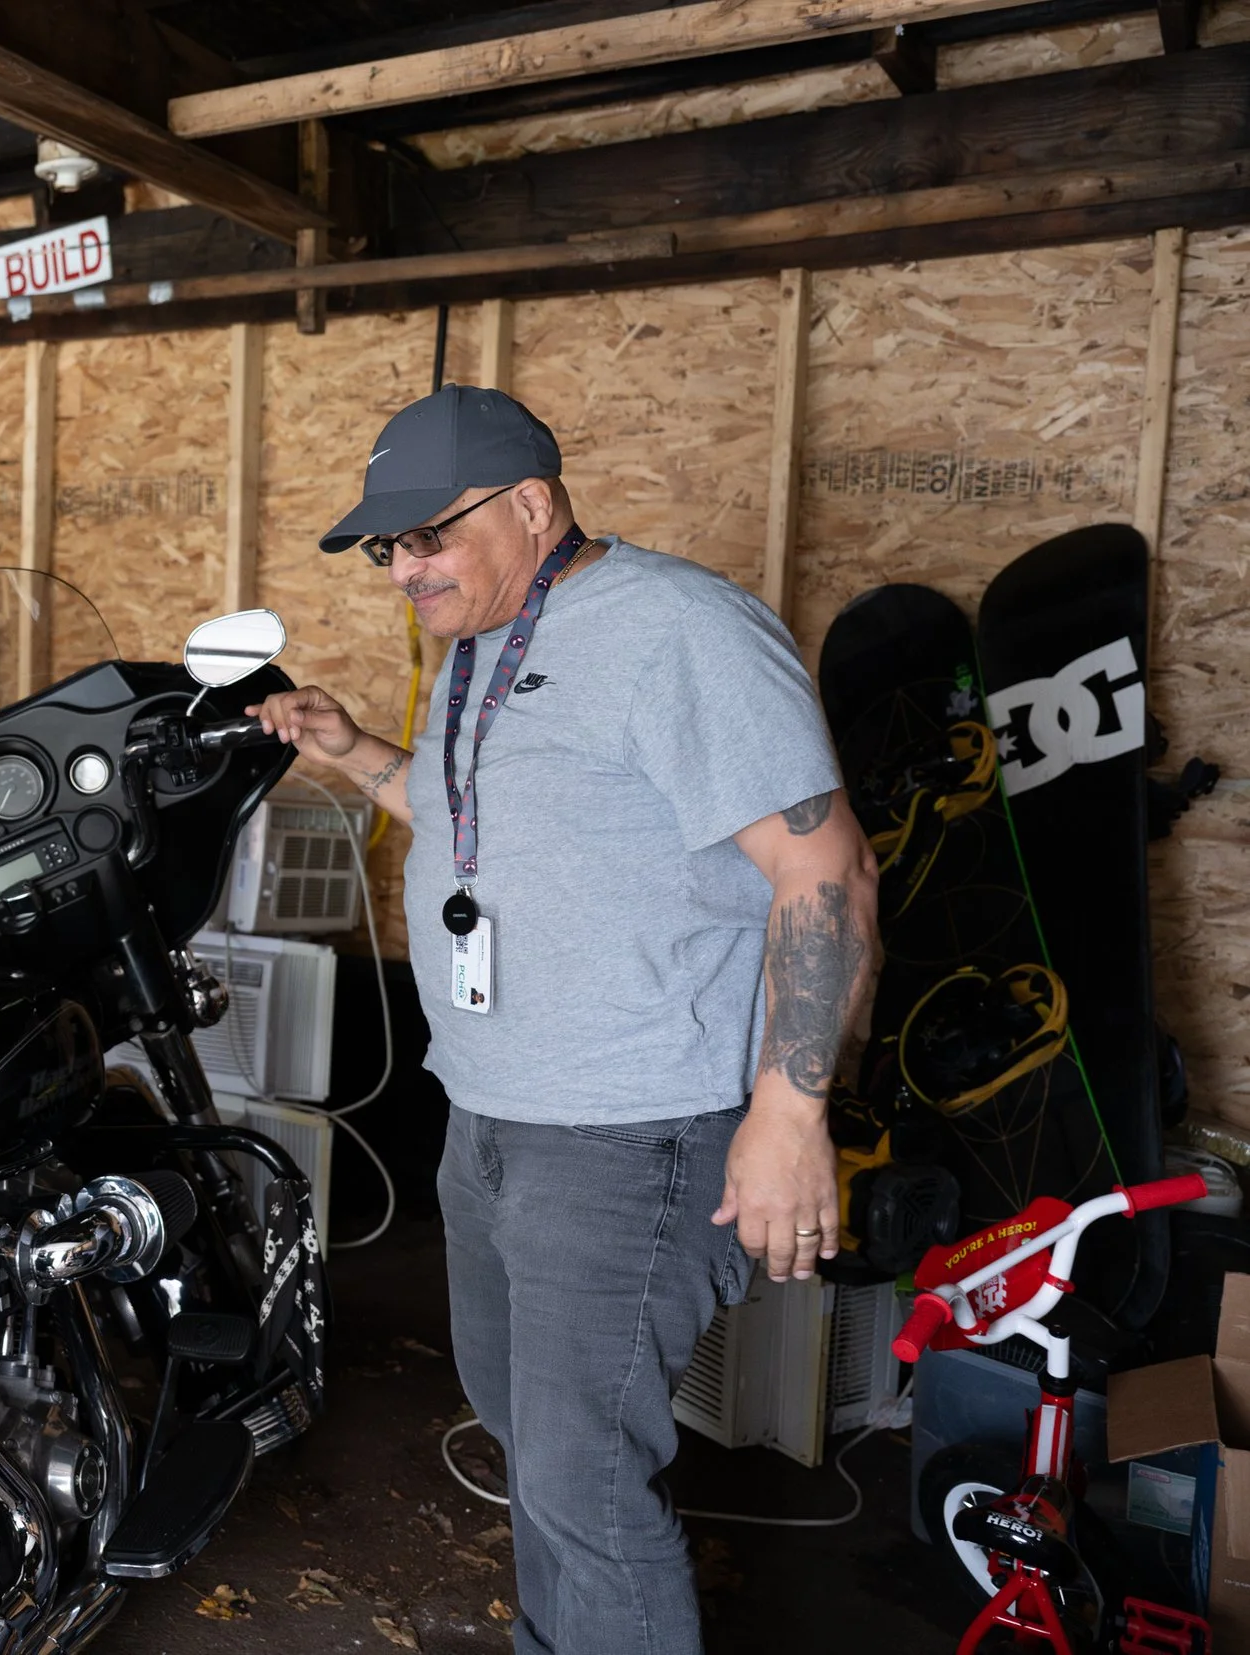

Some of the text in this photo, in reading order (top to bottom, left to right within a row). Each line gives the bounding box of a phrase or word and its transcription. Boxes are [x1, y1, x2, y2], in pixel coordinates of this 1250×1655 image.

[5, 230, 102, 296] BUILD
[985, 635, 1146, 798] DC
[945, 1221, 1037, 1269] YOU'RE A HERO!
[986, 1514, 1044, 1542] HERO!
